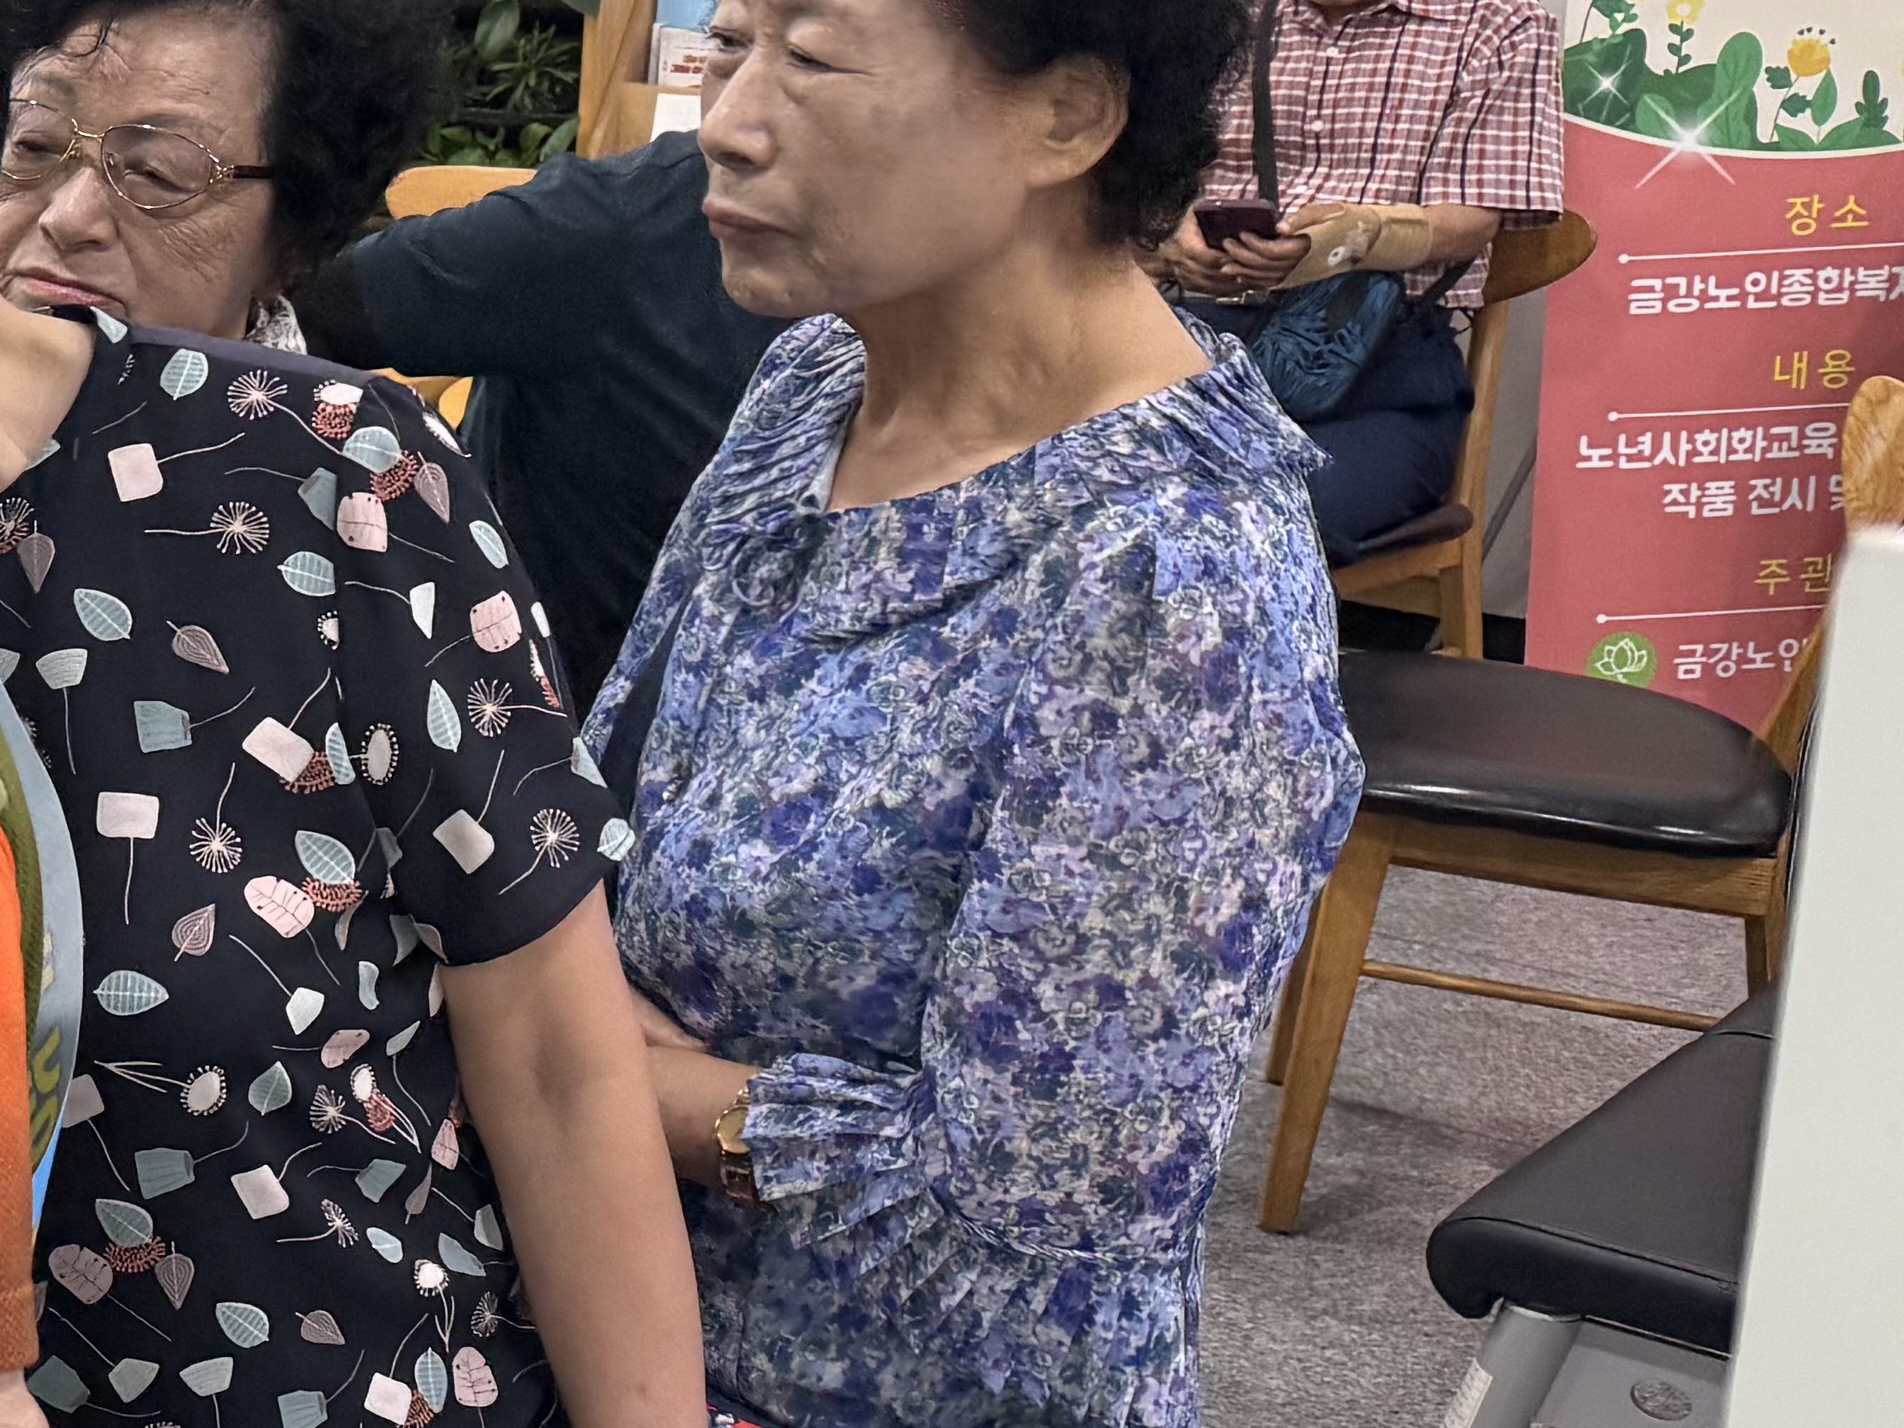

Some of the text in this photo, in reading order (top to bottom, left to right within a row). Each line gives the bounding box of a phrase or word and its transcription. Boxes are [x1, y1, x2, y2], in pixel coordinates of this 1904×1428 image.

[1785, 194, 1870, 236] 장소
[1774, 349, 1855, 390] 내용
[1575, 420, 1838, 470] 노년사회화교육
[1663, 480, 1737, 519] 작품
[1748, 475, 1817, 516] 전시
[1754, 553, 1832, 596] 주관
